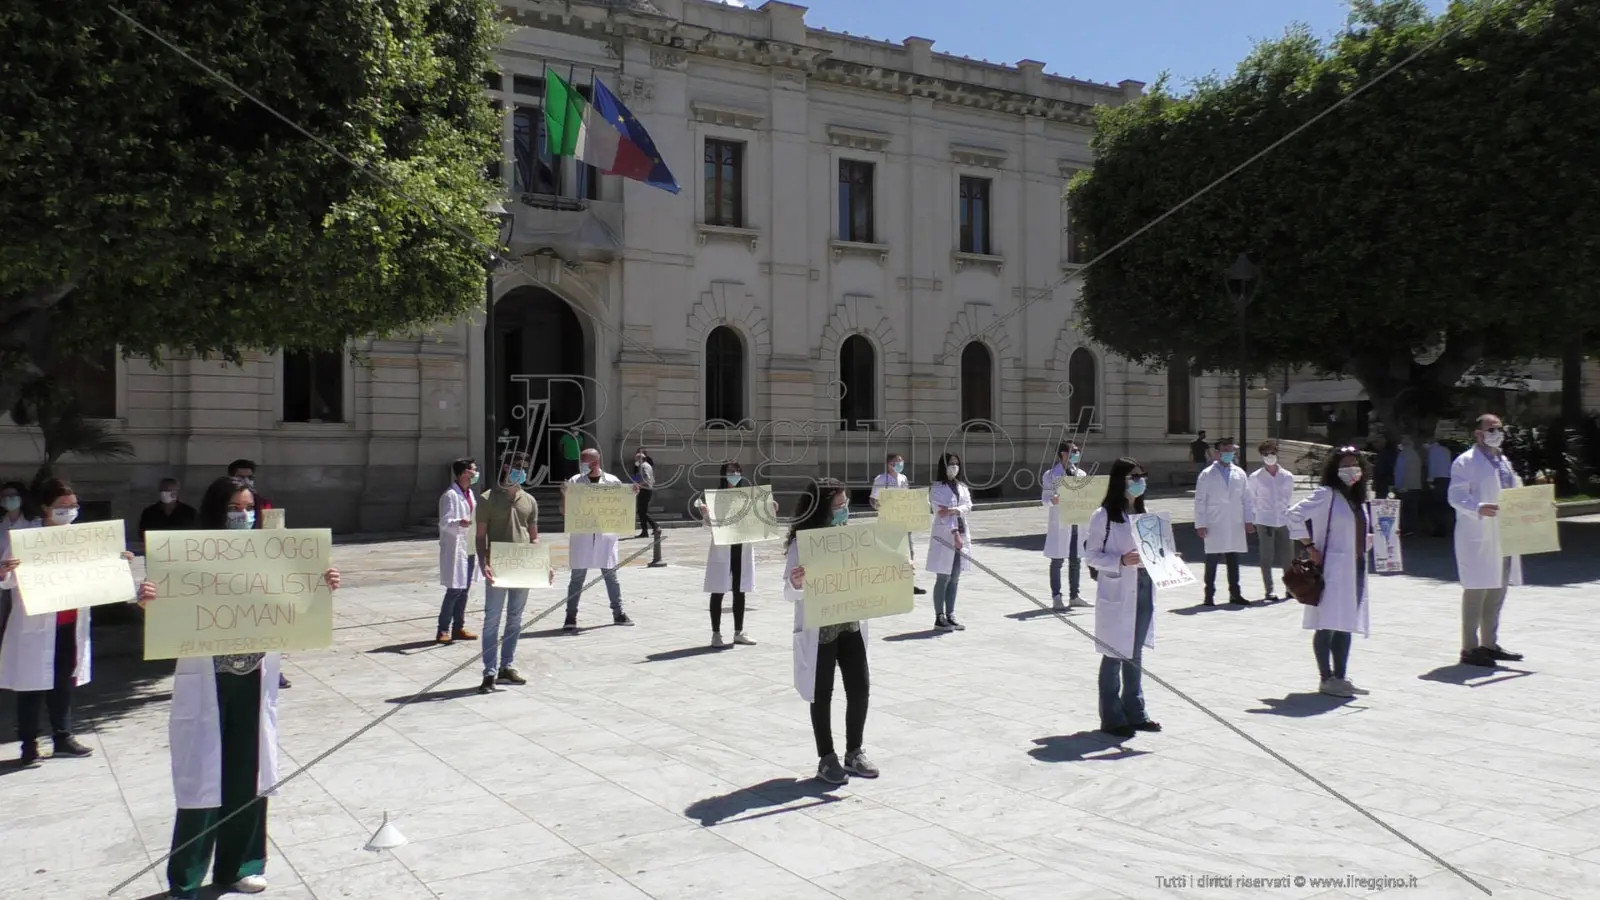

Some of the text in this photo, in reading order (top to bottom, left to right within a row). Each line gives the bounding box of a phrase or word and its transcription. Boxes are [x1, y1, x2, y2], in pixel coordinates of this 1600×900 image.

[22, 527, 117, 550] LA NOSTRA
[155, 536, 320, 562] 1 BORSA OGGI
[809, 528, 877, 557] MEDICI
[31, 545, 110, 568] BATTAGLIA
[841, 551, 859, 570] IN
[155, 571, 332, 598] 1 SPECIALISTA
[195, 602, 296, 631] DOMANI
